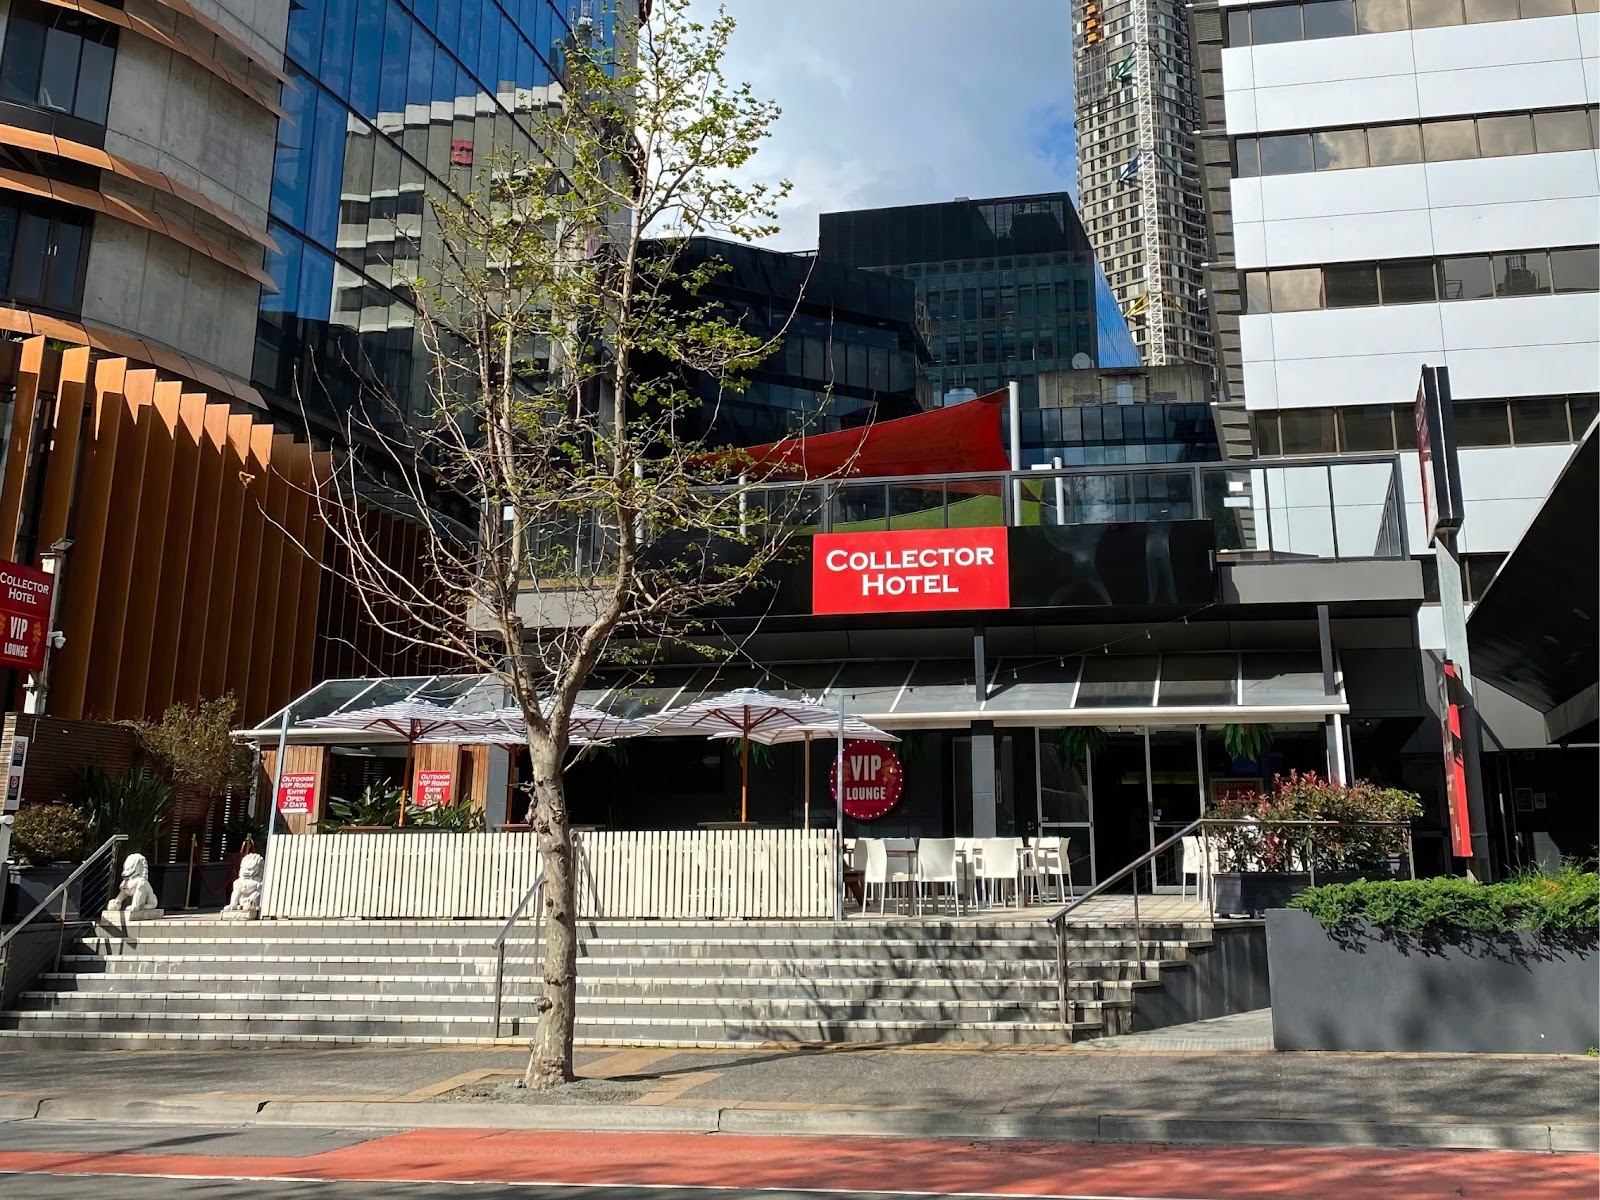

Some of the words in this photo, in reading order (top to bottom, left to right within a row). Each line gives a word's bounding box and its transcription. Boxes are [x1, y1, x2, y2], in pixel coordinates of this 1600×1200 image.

[826, 547, 995, 572] COLLECTOR
[0, 572, 49, 594] COLLECTOR
[862, 574, 959, 596] HOTEL
[8, 587, 37, 605] HOTEL
[10, 616, 28, 641] VIP
[4, 642, 28, 658] LOUNGE
[850, 755, 882, 781] VIP
[846, 787, 886, 801] LOUNGE
